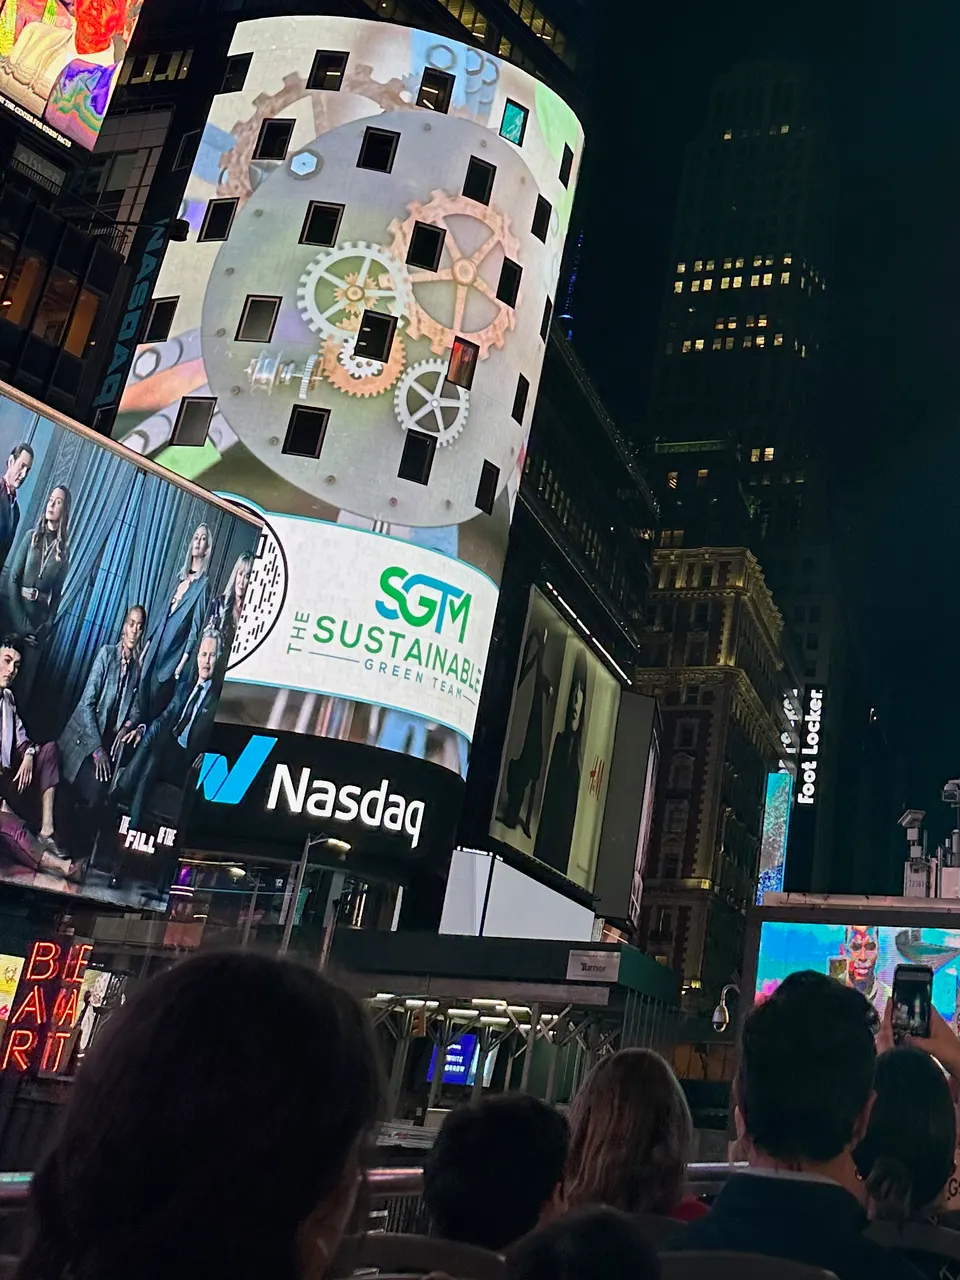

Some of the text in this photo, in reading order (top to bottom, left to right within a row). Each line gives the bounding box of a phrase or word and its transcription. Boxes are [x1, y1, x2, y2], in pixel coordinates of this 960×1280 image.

[93, 217, 170, 408] NASDAQ
[287, 610, 310, 654] THE
[375, 566, 472, 644] SGTM
[312, 615, 483, 694] SUSTAINABLE
[364, 658, 463, 700] GREEN TEAM
[266, 763, 426, 849] Nasdaq
[797, 760, 817, 804] Foot
[124, 829, 155, 854] FALL
